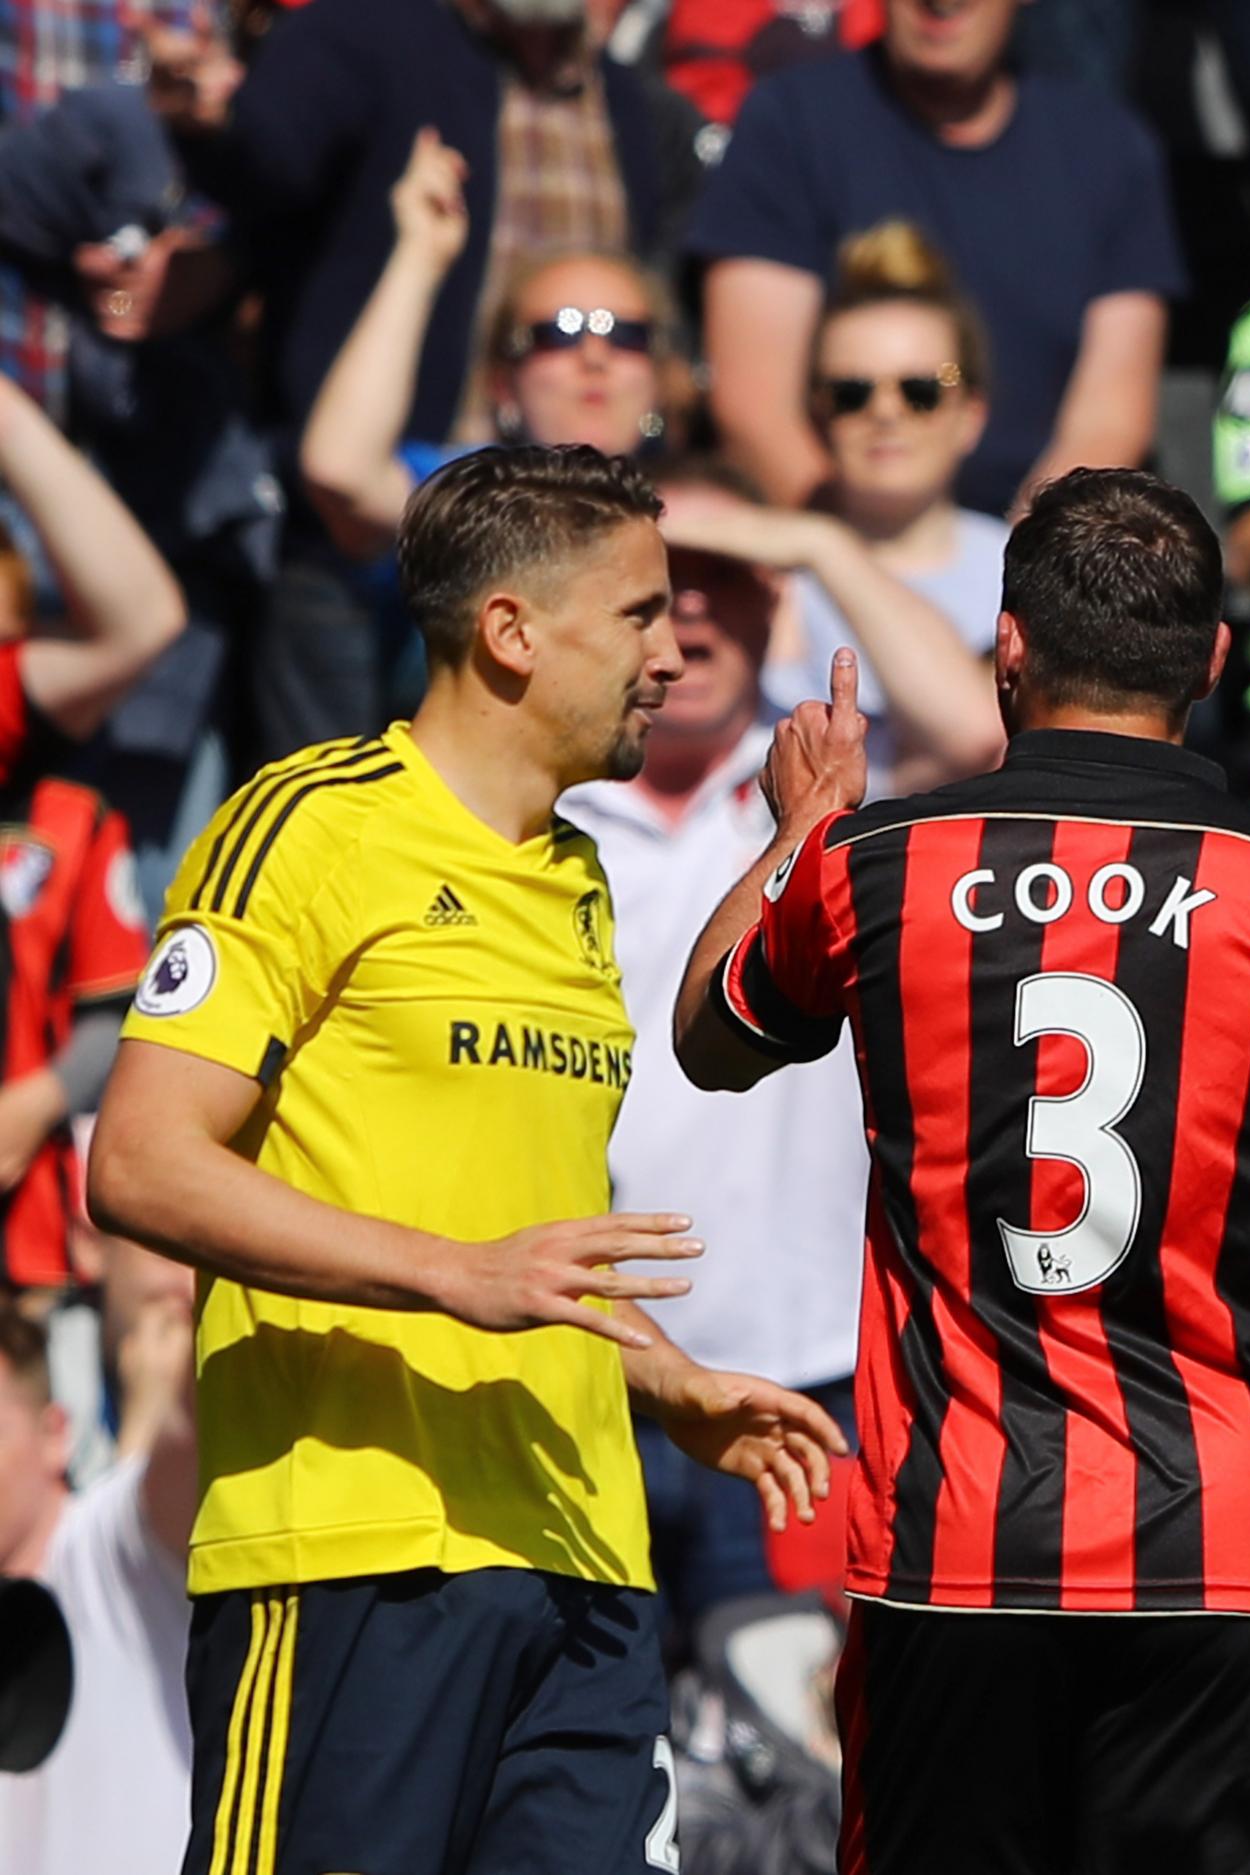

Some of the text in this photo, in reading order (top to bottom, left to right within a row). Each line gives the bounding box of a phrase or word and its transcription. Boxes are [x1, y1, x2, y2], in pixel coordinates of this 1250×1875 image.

[424, 911, 478, 927] adidas
[952, 863, 1216, 949] COOK
[449, 1020, 632, 1092] RAMSDENS
[996, 971, 1147, 1295] 3
